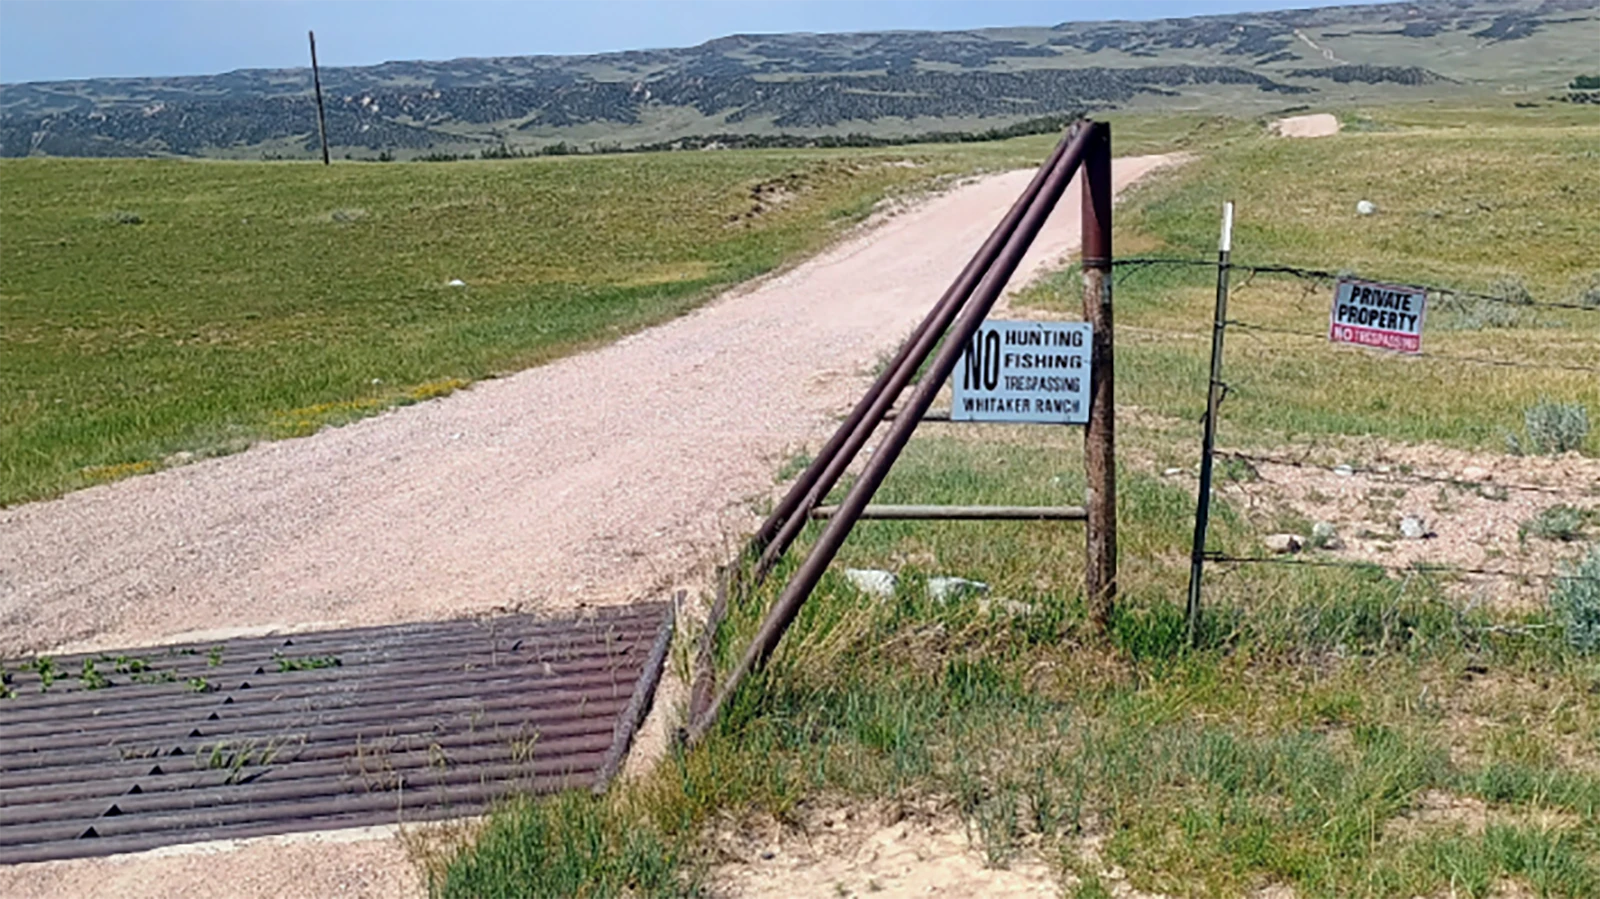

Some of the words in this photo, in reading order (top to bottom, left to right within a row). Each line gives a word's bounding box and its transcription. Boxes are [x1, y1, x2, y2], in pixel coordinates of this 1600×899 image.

[1350, 285, 1412, 312] PRIVATE
[1337, 304, 1417, 332] PROPERTY
[1005, 330, 1083, 347] HUNTING
[1334, 327, 1353, 341] NO
[963, 329, 1000, 391] NO
[1004, 353, 1082, 369] FISHING
[1004, 376, 1081, 393] TRESPASSING
[962, 397, 1031, 413] WHITAKER
[1036, 398, 1081, 414] RANCH
